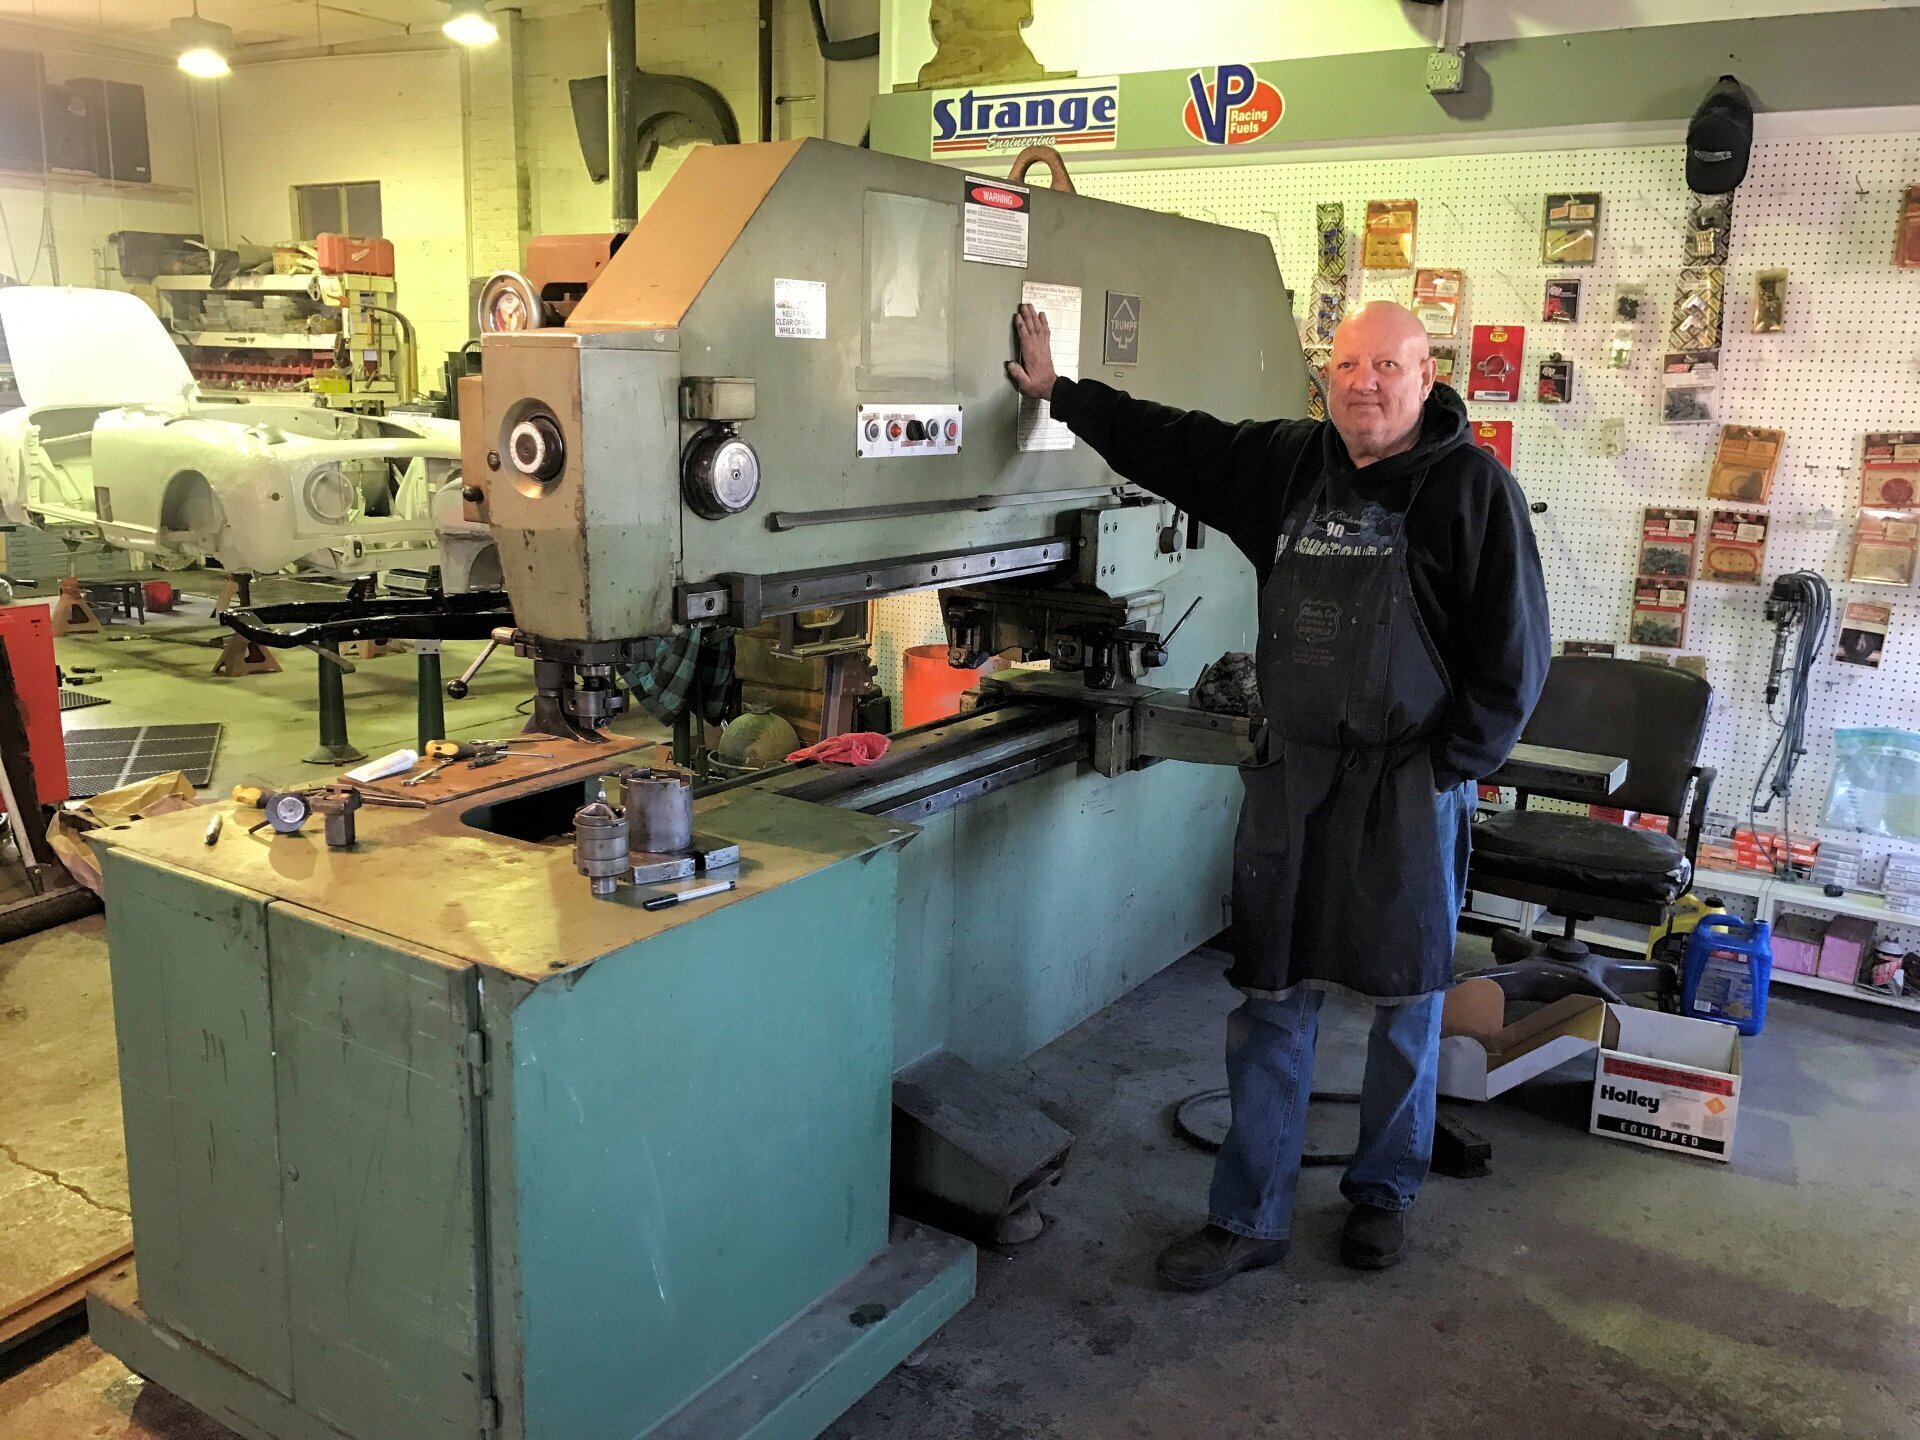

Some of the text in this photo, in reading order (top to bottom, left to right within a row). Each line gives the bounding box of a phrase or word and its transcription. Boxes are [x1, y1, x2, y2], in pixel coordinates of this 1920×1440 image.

[1189, 63, 1256, 145] VP
[933, 89, 1116, 140] Strange
[1230, 107, 1268, 124] Racing
[1230, 121, 1259, 135] Fuels
[985, 133, 1057, 152] Engineering
[982, 190, 1013, 205] WARNING
[775, 318, 793, 326] CLEAR
[779, 326, 796, 335] WHILE
[1110, 319, 1138, 332] TRUMPF
[1600, 1084, 1660, 1114] Holley
[1620, 1121, 1699, 1147] EQUIPPED
